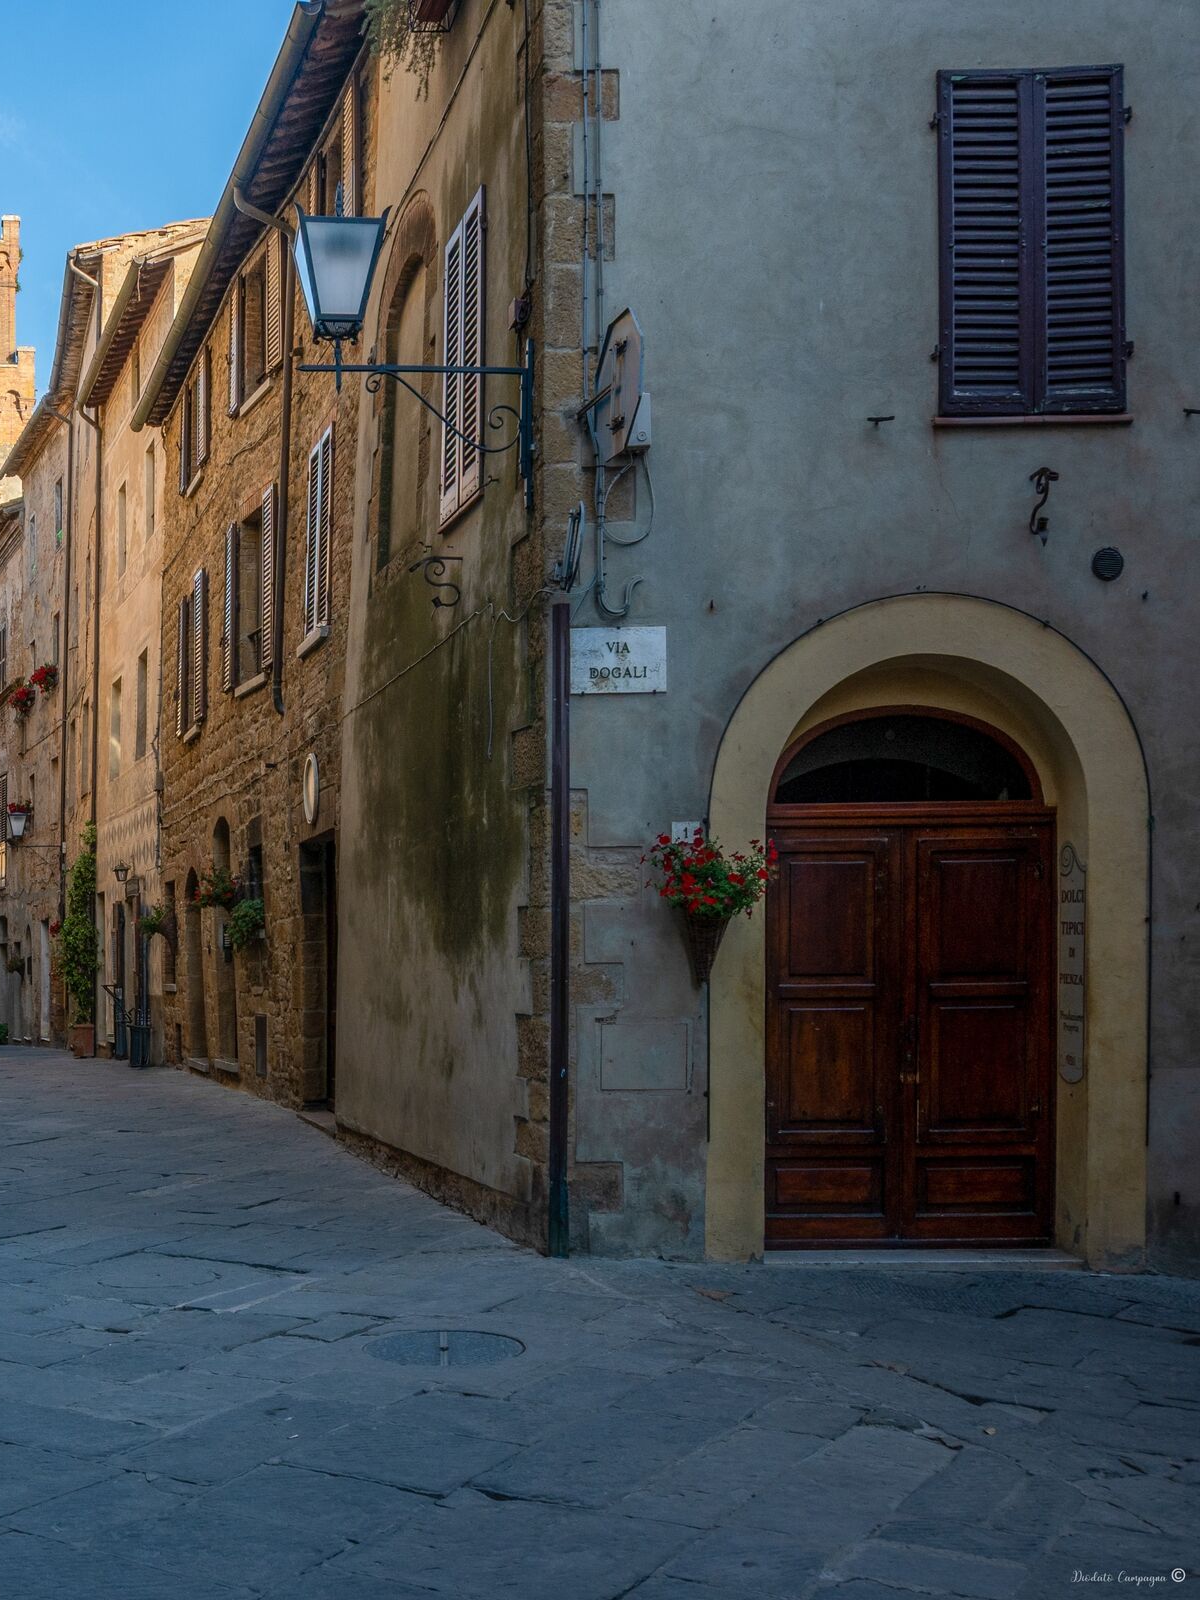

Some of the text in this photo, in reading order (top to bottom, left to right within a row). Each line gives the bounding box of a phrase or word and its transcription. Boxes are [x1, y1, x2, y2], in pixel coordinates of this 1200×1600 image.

[605, 641, 631, 654] VIA
[589, 666, 648, 679] DOGALI
[682, 826, 689, 839] 1
[1061, 889, 1085, 903] DOLCI
[1060, 921, 1085, 935] TIPICI
[1068, 947, 1076, 958] DI
[1059, 973, 1084, 985] PIENZA
